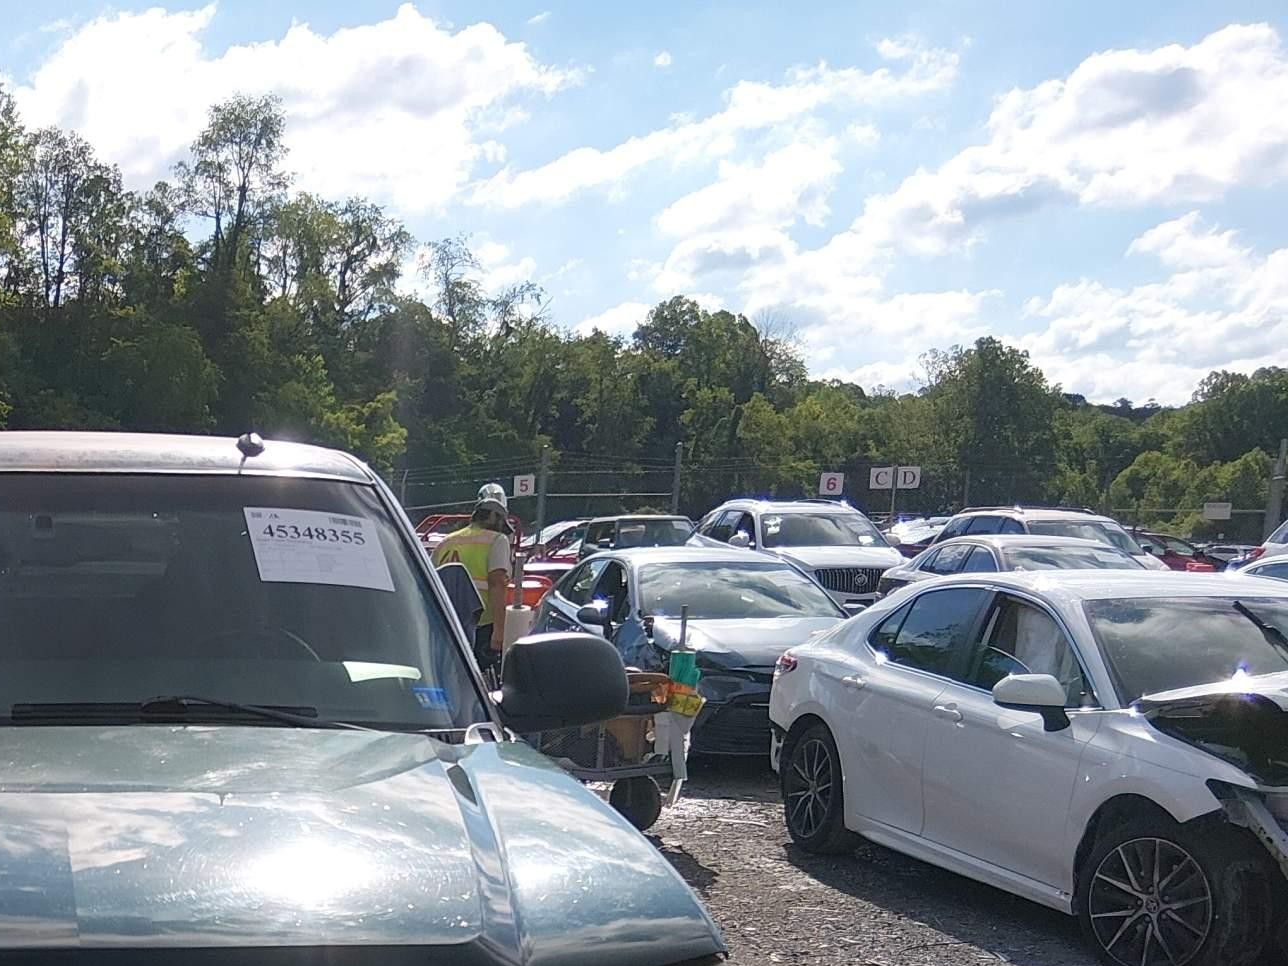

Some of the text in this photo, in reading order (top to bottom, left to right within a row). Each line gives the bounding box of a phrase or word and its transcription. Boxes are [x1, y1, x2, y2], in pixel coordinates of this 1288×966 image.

[826, 477, 837, 491] 6
[875, 471, 888, 486] C
[902, 471, 916, 485] D
[519, 479, 529, 493] 5
[263, 524, 366, 546] 45348355
